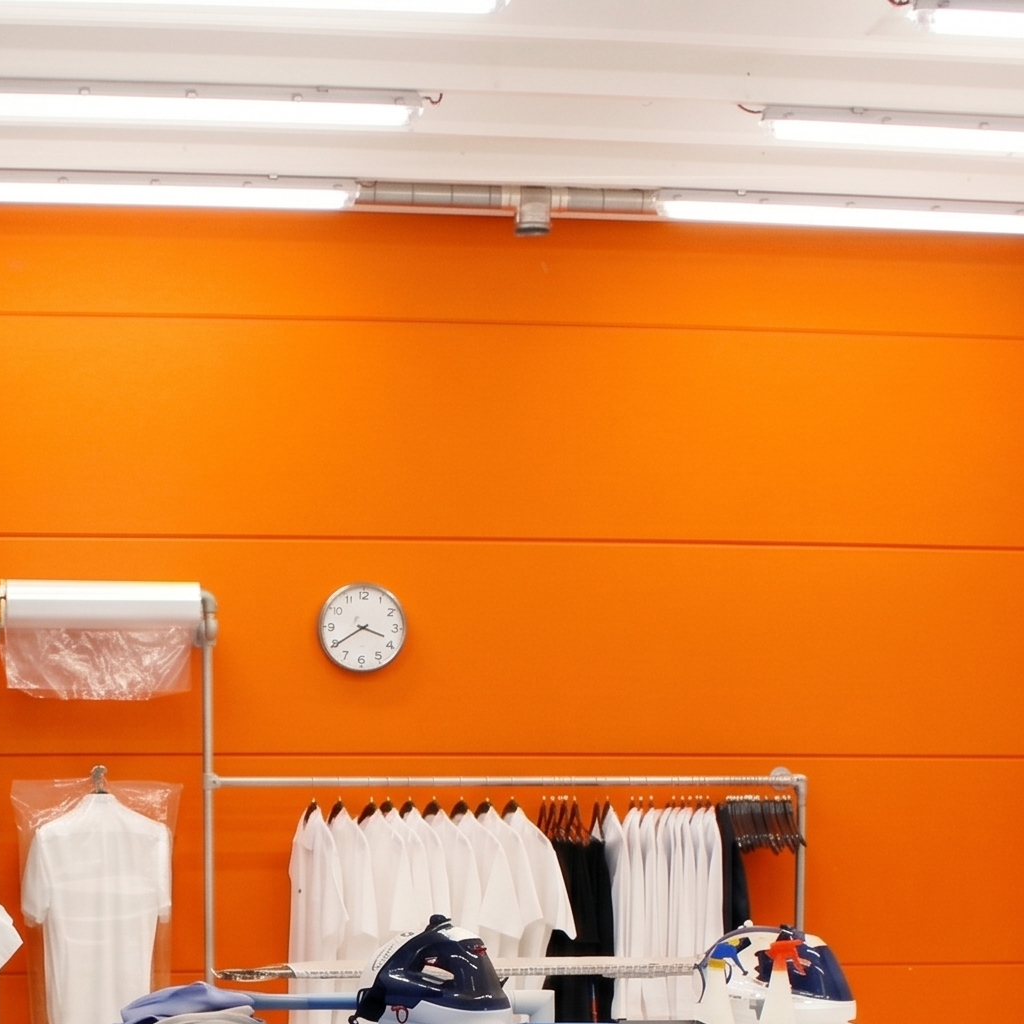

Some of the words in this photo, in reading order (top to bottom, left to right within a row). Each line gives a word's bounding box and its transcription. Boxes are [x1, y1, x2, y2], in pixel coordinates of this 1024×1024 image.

[345, 595, 353, 604] 11
[358, 591, 369, 600] 12
[378, 596, 382, 604] 1
[333, 606, 343, 615] 10
[386, 607, 395, 617] 2
[327, 622, 335, 632] 9
[390, 623, 399, 633] 3
[385, 640, 394, 649] 4
[342, 650, 349, 660] 7
[357, 655, 365, 664] 6
[374, 651, 383, 661] 5
